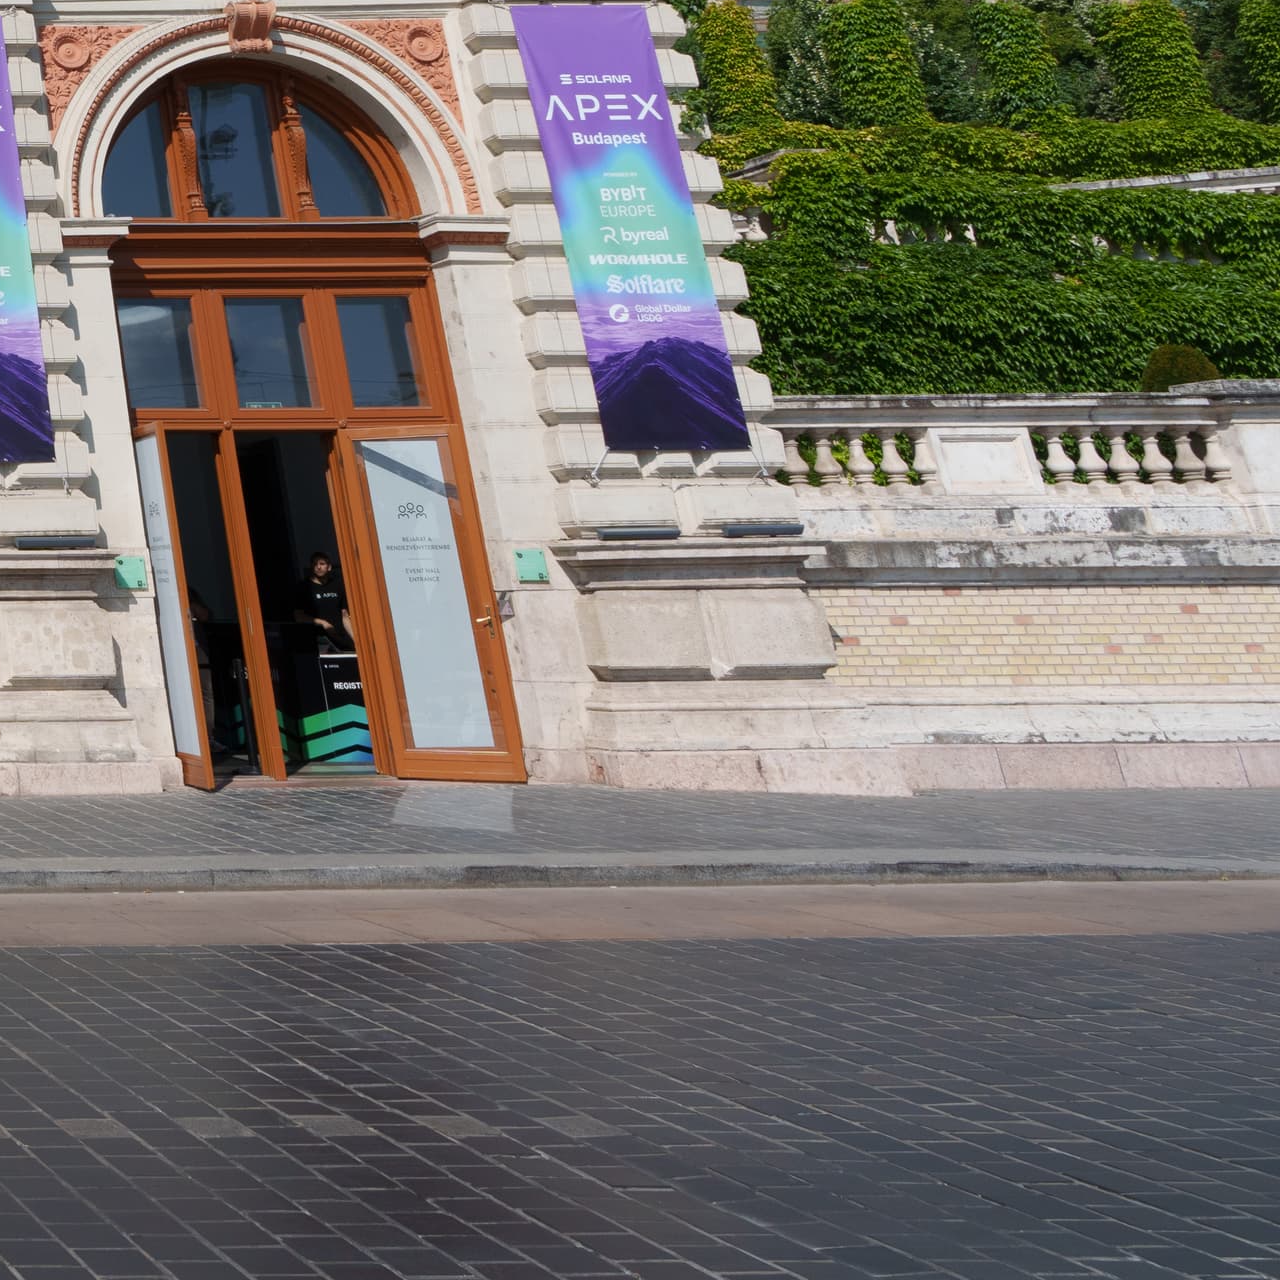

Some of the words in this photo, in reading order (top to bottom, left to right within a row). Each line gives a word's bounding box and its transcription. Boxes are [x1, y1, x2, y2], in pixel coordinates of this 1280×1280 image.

[575, 74, 632, 84] SOLANA
[545, 94, 664, 120] APEX
[572, 132, 648, 148] Budapest
[600, 184, 646, 202] BYBIT
[600, 204, 656, 217] EUROPE
[620, 226, 669, 245] byreal
[588, 254, 688, 265] WORMHOLE
[606, 274, 686, 294] Solflare
[634, 304, 662, 313] Global
[664, 304, 691, 312] Dollar
[636, 313, 664, 322] USDG
[333, 682, 363, 690] REGIST
